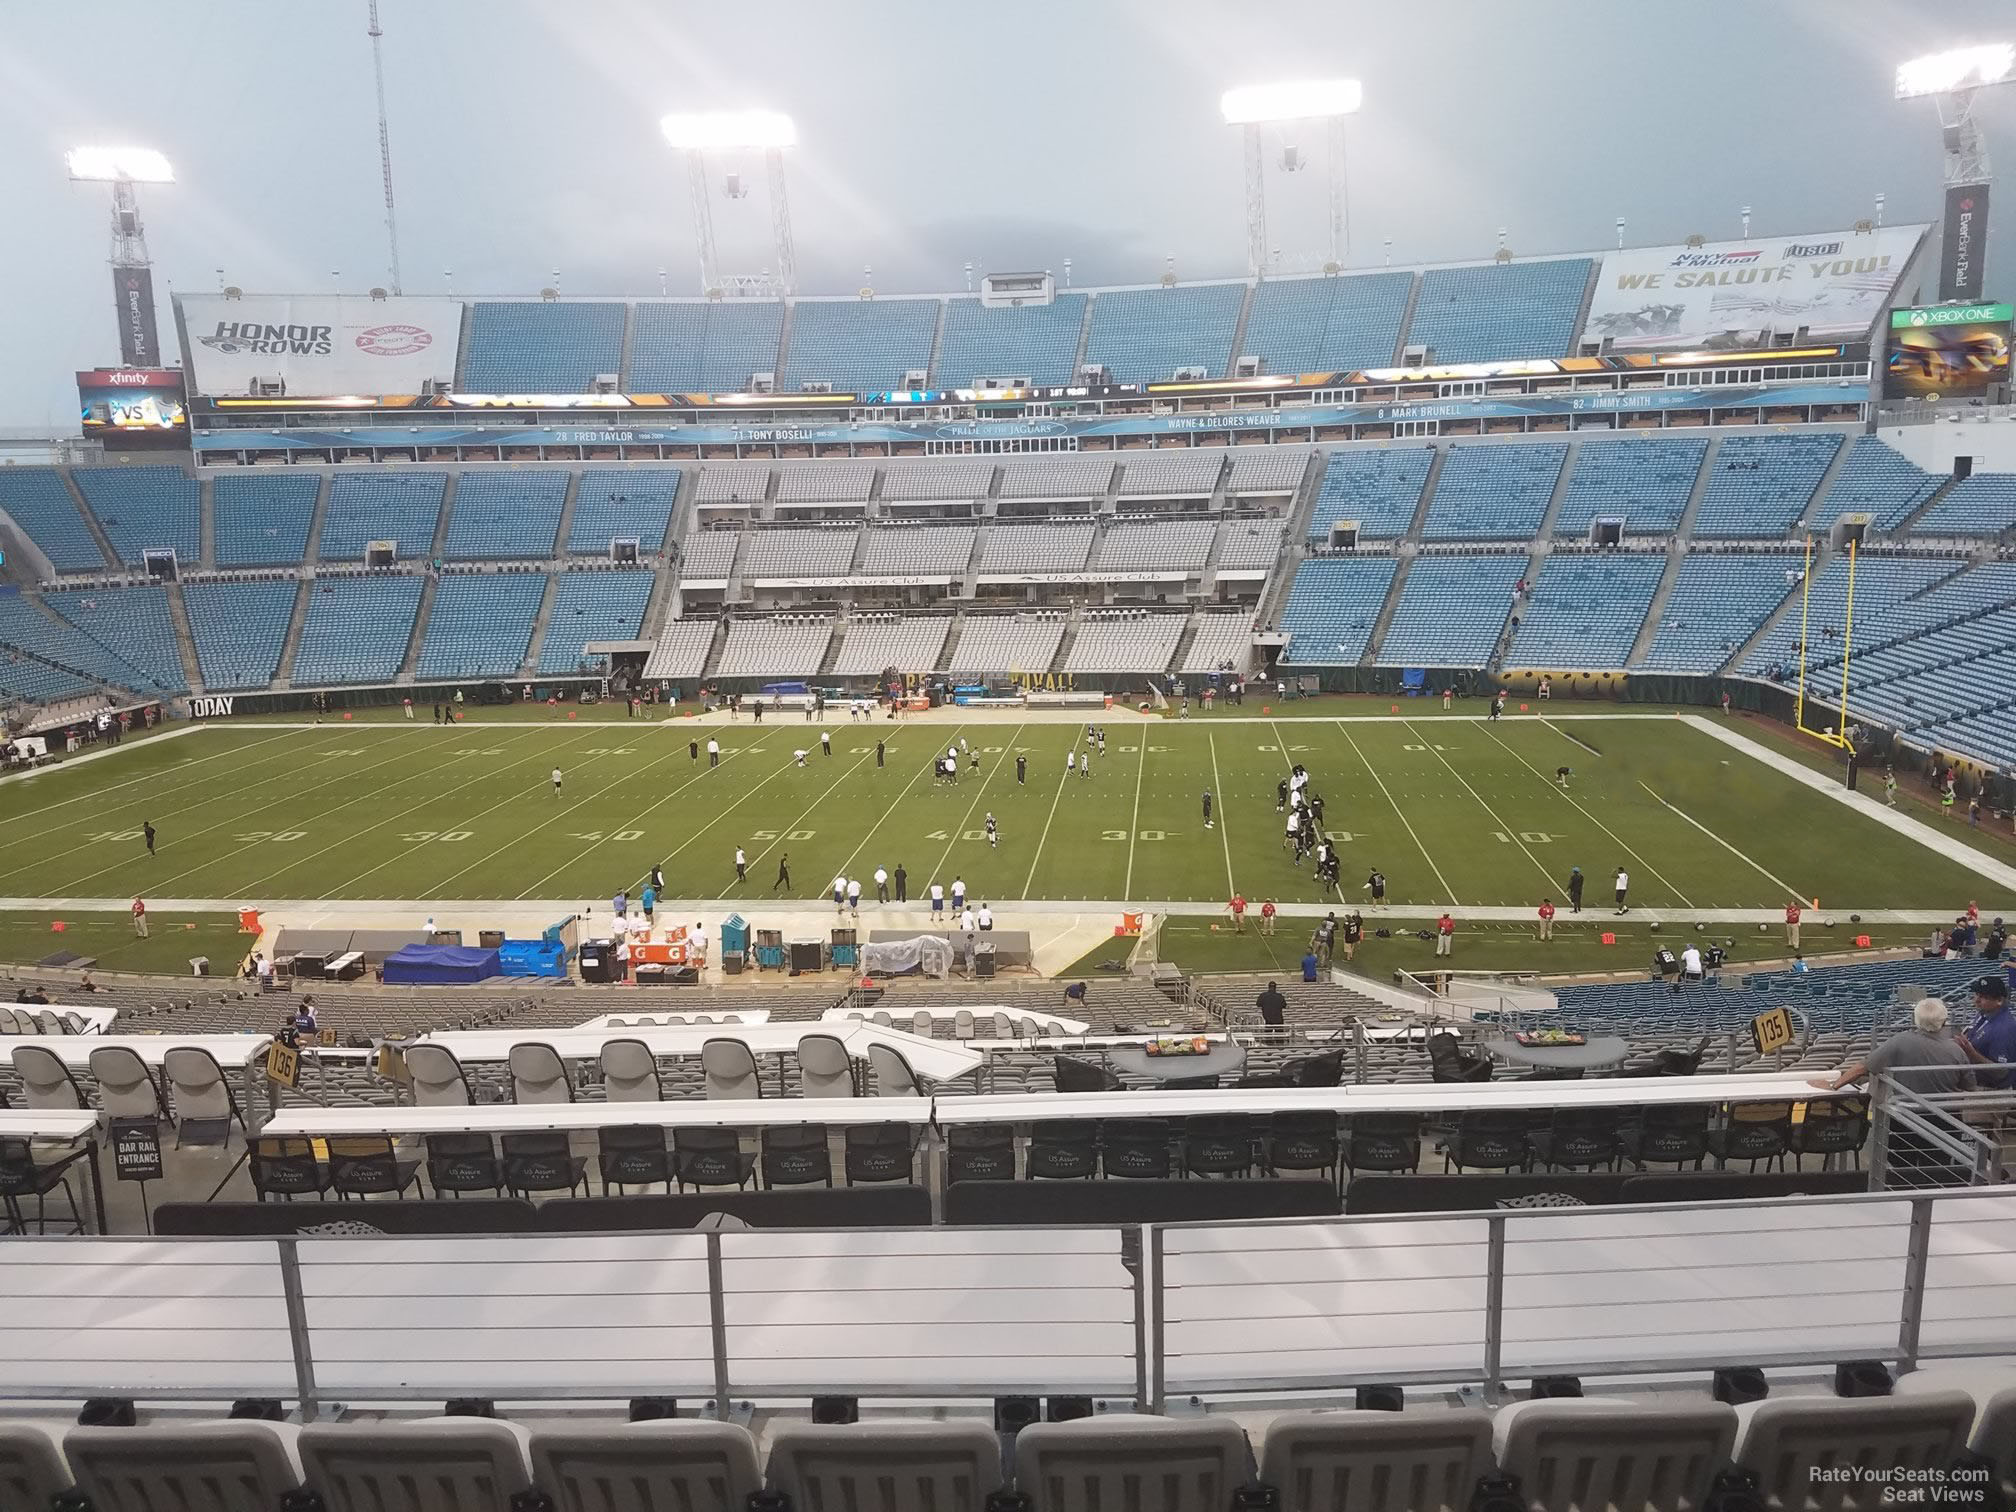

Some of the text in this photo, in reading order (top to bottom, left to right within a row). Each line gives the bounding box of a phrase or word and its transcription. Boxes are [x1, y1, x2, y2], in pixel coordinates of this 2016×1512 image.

[1794, 245, 1829, 256] USO
[1956, 212, 1973, 287] EverBank Field
[1676, 253, 1726, 262] Navy
[1687, 256, 1761, 267] Mutual
[1617, 255, 1891, 290] WE SALUTE YOU!
[1929, 308, 1996, 322] XBOX ONE
[129, 290, 145, 355] EverBank Field
[213, 321, 332, 342] HONOR
[250, 340, 332, 355] ROWS
[109, 372, 149, 385] xfinity
[1573, 400, 1584, 409] 82
[1592, 398, 1620, 409] JIMMY
[1622, 396, 1651, 407] SMITH
[122, 406, 143, 420] VS
[1378, 409, 1384, 419] 8
[1391, 407, 1418, 418] MARK
[1420, 405, 1462, 417] BRUNELL
[1168, 419, 1197, 429] WAYNE
[1199, 418, 1204, 428] &
[1207, 416, 1244, 428] DELORES
[1245, 414, 1280, 425] WEAVER
[734, 431, 743, 441] 71
[747, 431, 773, 441] TONY
[775, 429, 813, 441] BOSELLI
[952, 427, 980, 435] PRIDE
[1010, 424, 1051, 435] JAGUARS
[556, 432, 567, 441] 28
[575, 431, 597, 441] FRED
[600, 431, 633, 441] TAYLOR
[837, 577, 888, 585] Assure
[891, 576, 925, 585] Club
[1046, 572, 1161, 582] US Assure Club
[235, 831, 308, 841] 20
[401, 831, 474, 841] 30
[576, 830, 646, 840] 40
[749, 830, 817, 840] 50
[924, 830, 990, 840] 40
[1100, 830, 1166, 841] 30
[1488, 831, 1552, 843] 10
[634, 947, 646, 960] G
[669, 947, 681, 960] G
[1761, 1014, 1784, 1044] 135
[273, 1049, 293, 1078] 136
[119, 1141, 156, 1152] BAR RAIL
[118, 1153, 159, 1164] ENTRANCE
